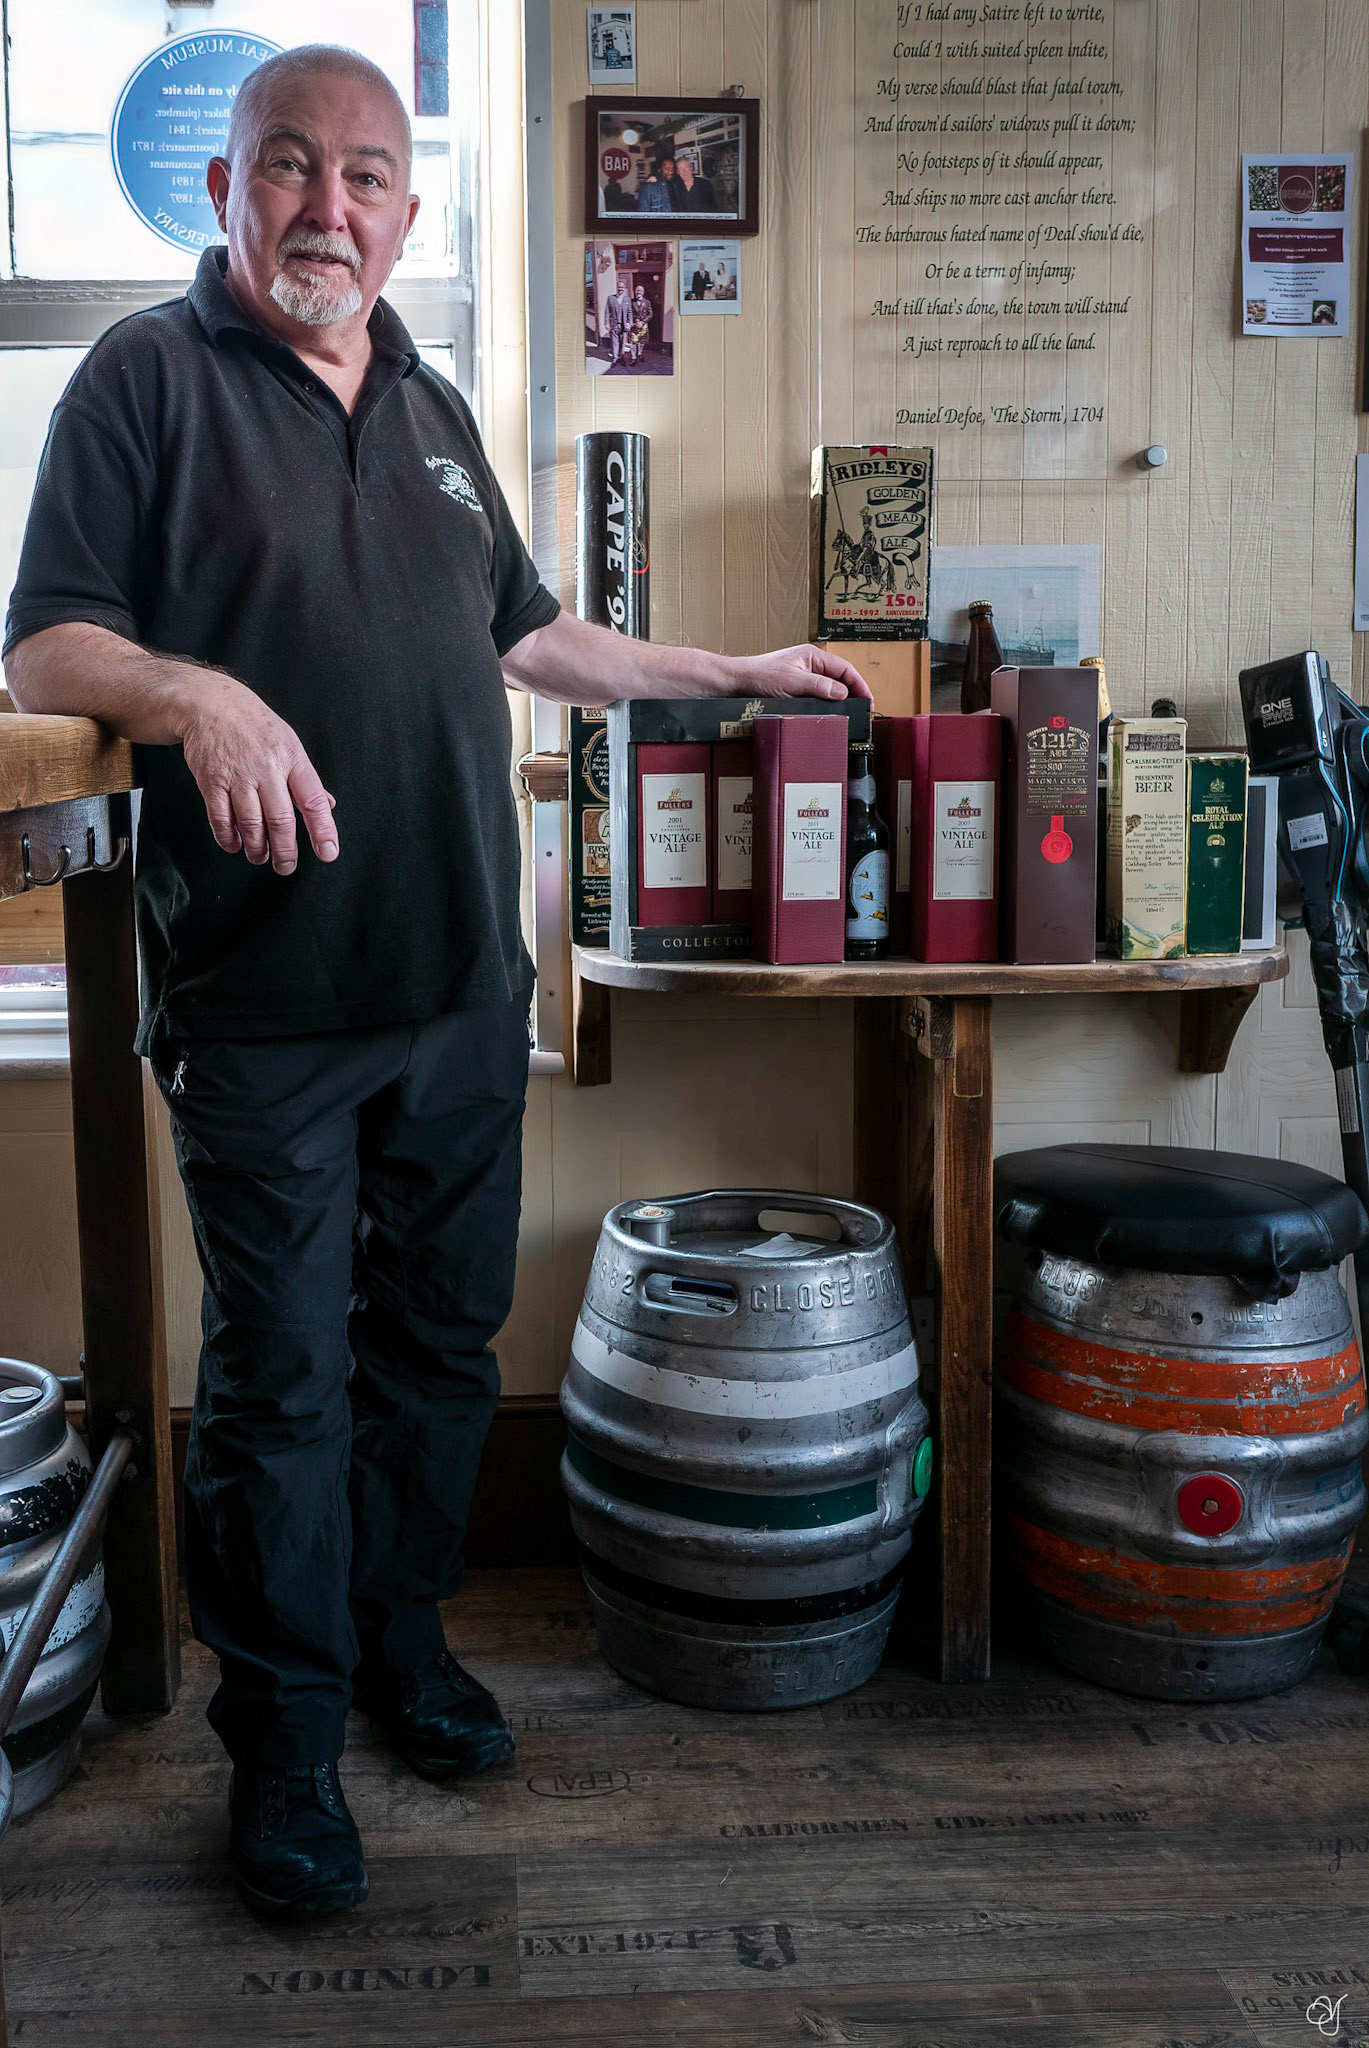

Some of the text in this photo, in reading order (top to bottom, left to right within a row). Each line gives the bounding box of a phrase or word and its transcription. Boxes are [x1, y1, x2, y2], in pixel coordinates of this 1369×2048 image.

[897, 3, 1105, 27] If I had any Satire left to write,
[894, 40, 1107, 64] Could I with suited spleen indite,
[877, 77, 1123, 101] My verse should blast that fatal town,
[864, 114, 1135, 138] And drown'd sailors' widows pull it down;
[605, 156, 629, 171] BAR
[898, 151, 1102, 175] No footsteps of it should appear,
[882, 188, 1117, 211] And ships no more cast anchor there.
[856, 224, 1144, 249] The barbarous hated name of Deal shou'd die,
[925, 261, 1075, 284] Or be a term of infamy;
[871, 297, 1131, 317] And till that's done, the town will stand
[903, 333, 1096, 358] A just reproach to all the land.
[896, 406, 1103, 429] Daniel Defoe, 'The Storm', 1704
[836, 460, 924, 481] RIDLEYS
[874, 488, 920, 500] GOLDEN
[884, 513, 918, 523] MEAD
[606, 451, 626, 633] CAPE '9
[886, 539, 908, 548] ALE
[1261, 698, 1292, 714] ONE
[1041, 733, 1077, 748] 1215
[1136, 782, 1173, 792] BEER
[1191, 814, 1242, 822] CELEBRATION
[650, 833, 701, 843] VINTAGE
[792, 832, 835, 840] VINTAGE
[804, 841, 822, 849] ALE
[942, 831, 987, 839] VINTAGE
[665, 844, 687, 852] ALE
[751, 1276, 855, 1313] CLOSE
[719, 1817, 908, 1838] CALIFORNIEN
[242, 1964, 494, 1994] LONDON
